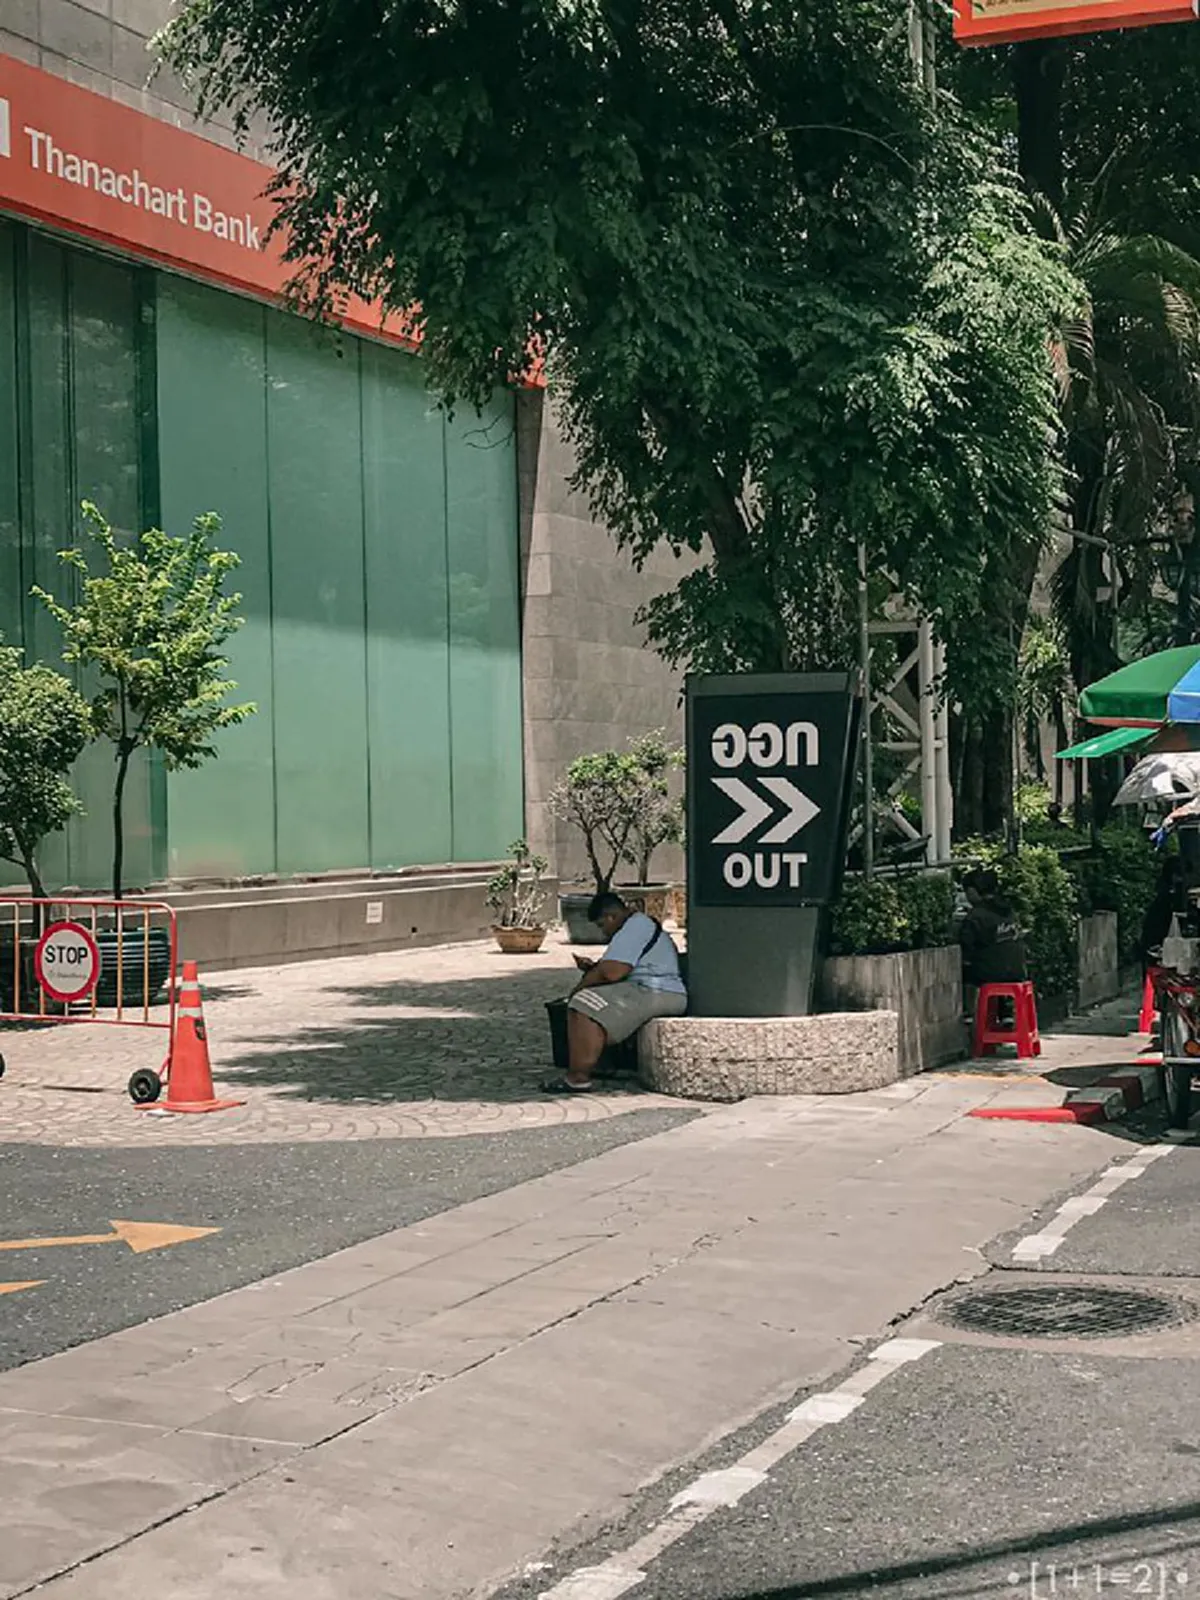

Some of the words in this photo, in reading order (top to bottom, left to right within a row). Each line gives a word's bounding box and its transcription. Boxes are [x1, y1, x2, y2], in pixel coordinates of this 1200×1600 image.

[24, 126, 188, 226] Thanachart
[193, 193, 262, 251] Bank
[711, 721, 819, 768] ออก
[723, 852, 808, 888] OUT
[44, 944, 88, 964] STOP
